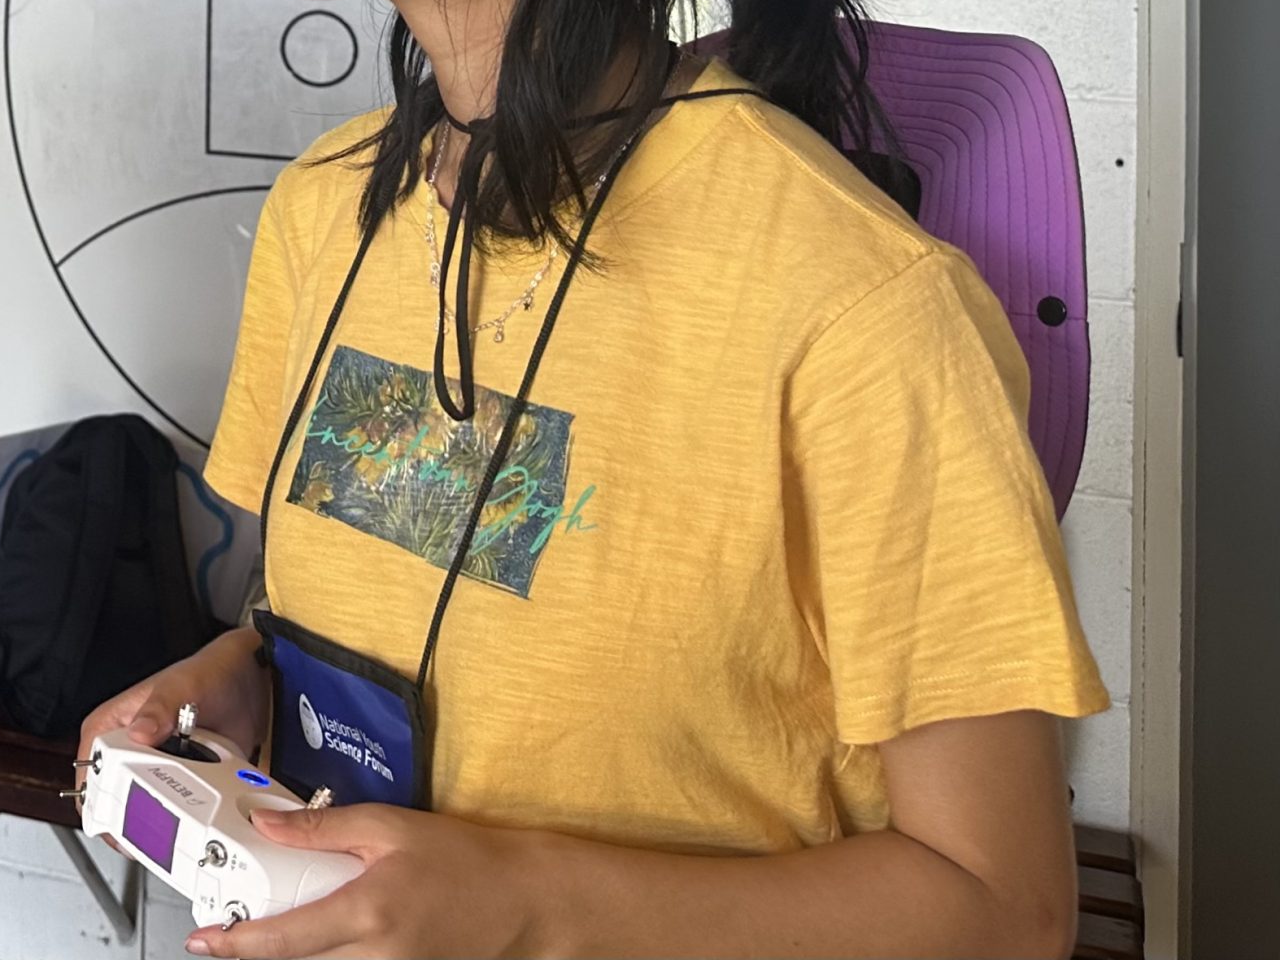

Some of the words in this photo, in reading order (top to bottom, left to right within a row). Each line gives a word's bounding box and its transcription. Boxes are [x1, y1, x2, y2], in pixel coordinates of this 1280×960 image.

[318, 712, 363, 744] National
[360, 729, 387, 760] Youth
[324, 731, 362, 764] Science
[364, 748, 394, 782] Forum
[148, 767, 193, 798] BETAFPV
